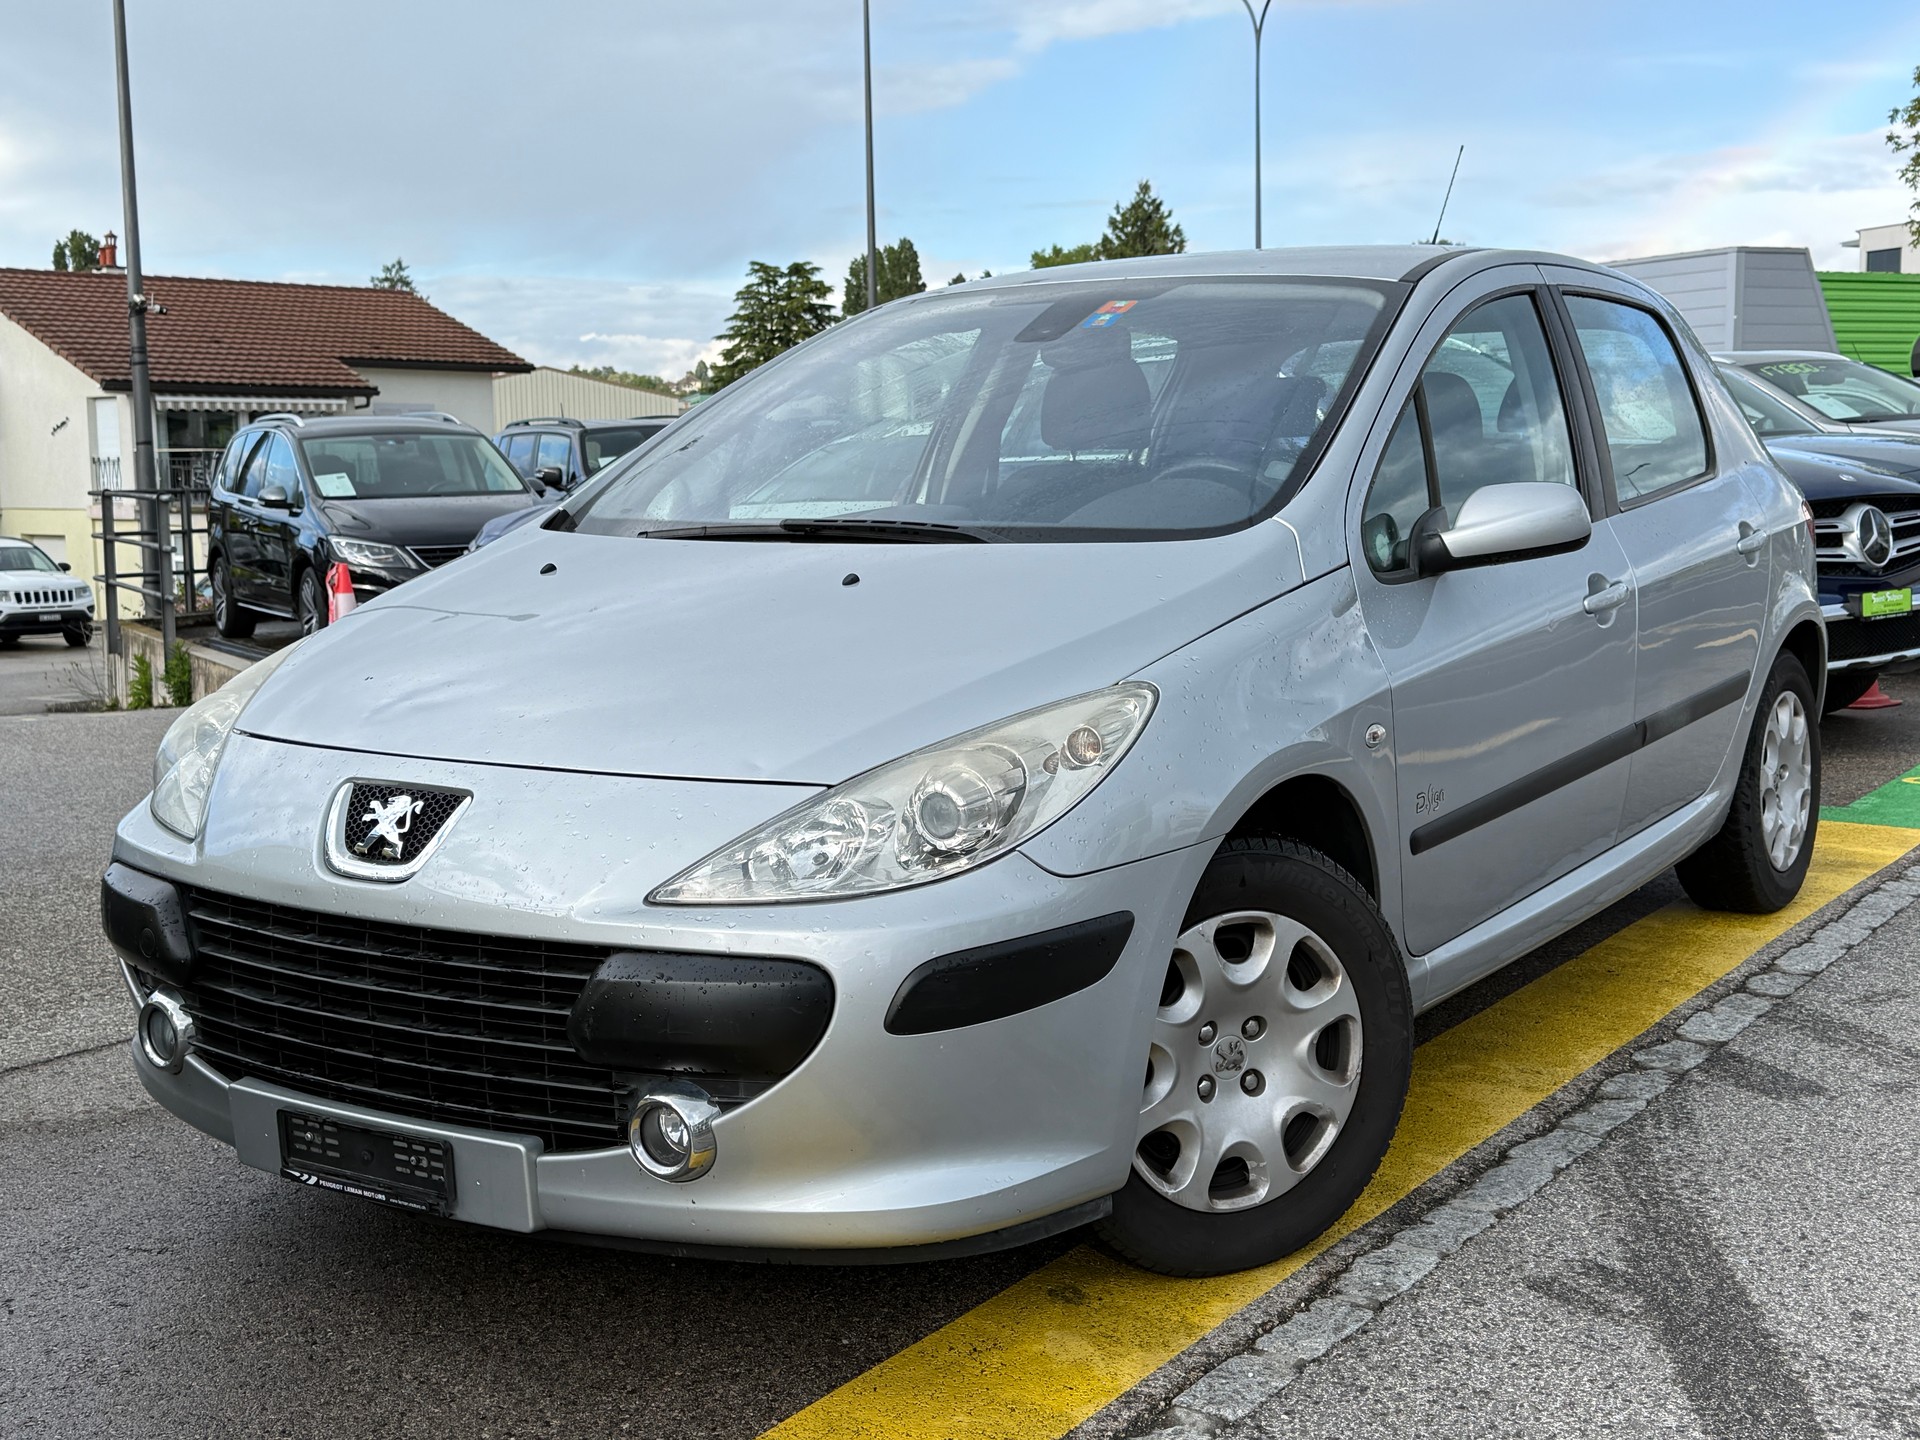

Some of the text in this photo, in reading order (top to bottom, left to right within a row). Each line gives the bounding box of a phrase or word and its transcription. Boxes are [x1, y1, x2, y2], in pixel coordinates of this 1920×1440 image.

[319, 1180, 343, 1190] PEUGEOT
[344, 1186, 363, 1196] LEMAN
[363, 1190, 386, 1201] MOTORS
